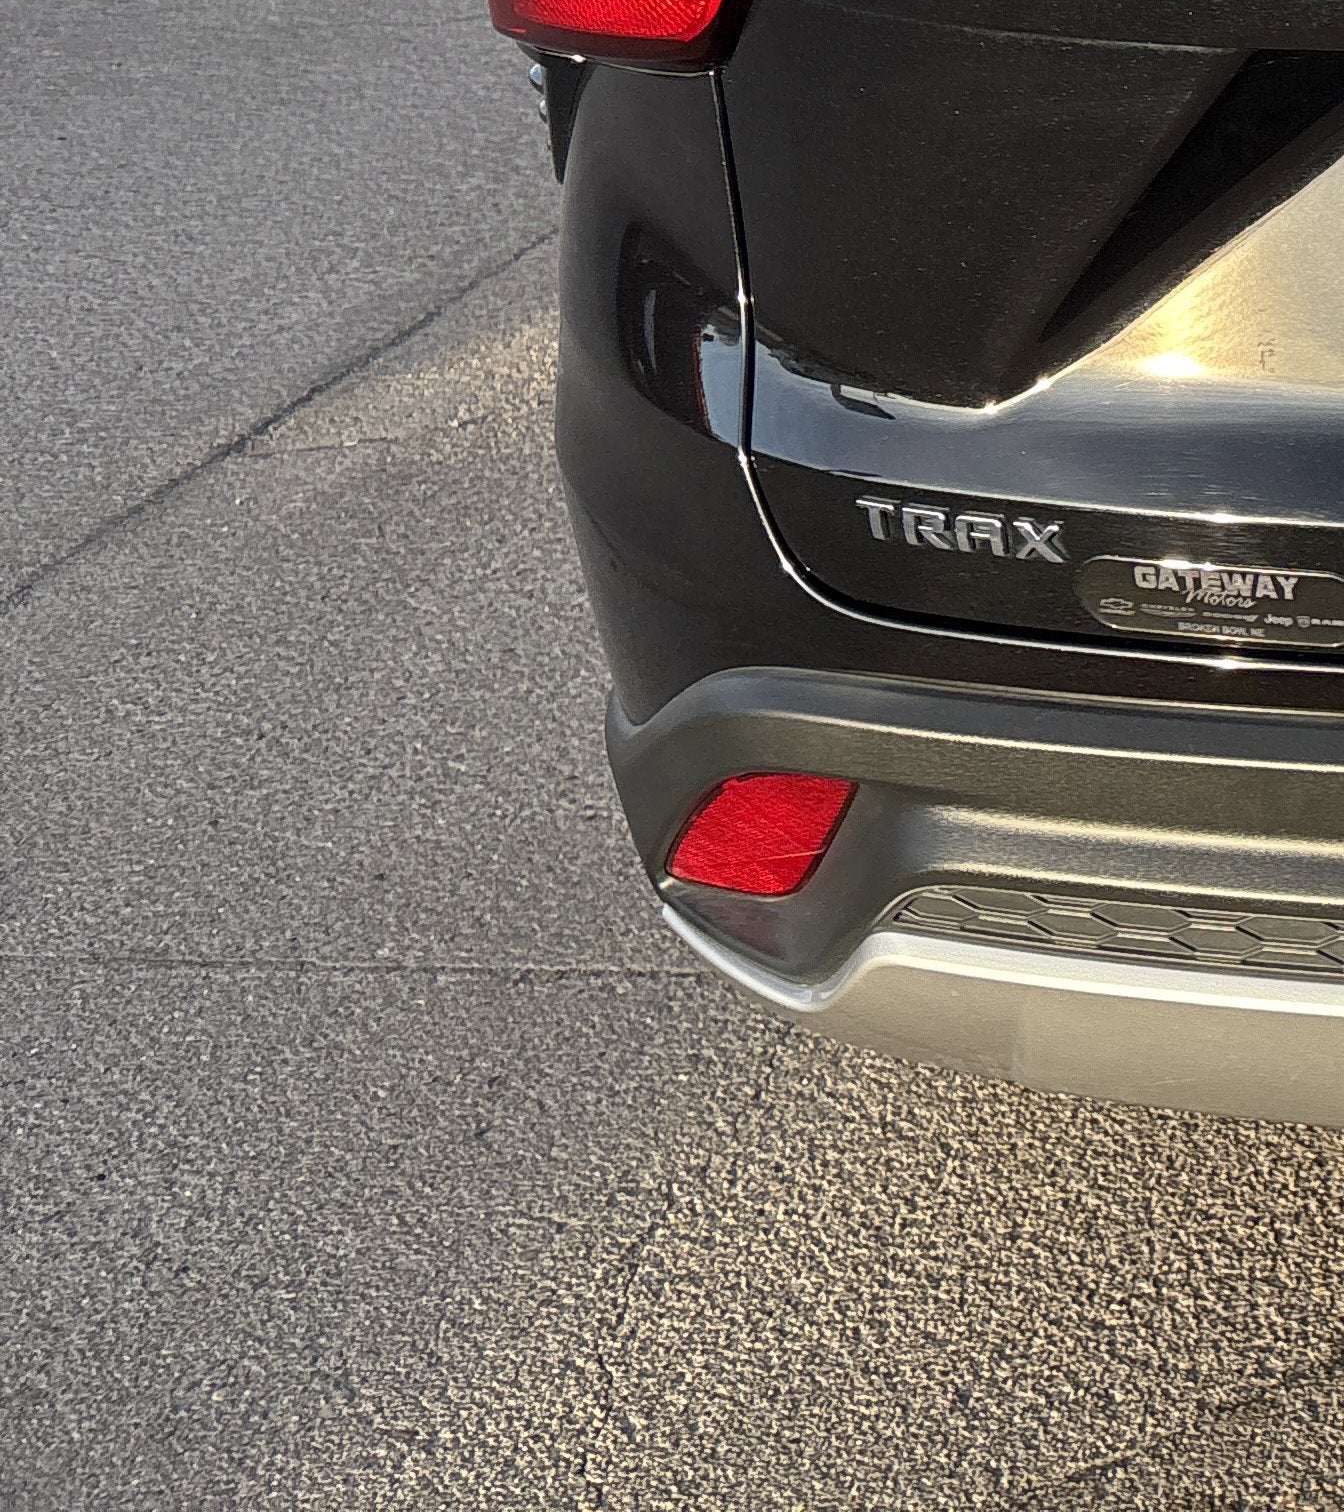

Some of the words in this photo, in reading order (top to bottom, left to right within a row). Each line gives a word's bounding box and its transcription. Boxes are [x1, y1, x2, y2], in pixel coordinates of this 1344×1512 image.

[855, 495, 1070, 564] TRAX
[1133, 565, 1299, 601] GATEWAY
[1181, 588, 1257, 609] Motors
